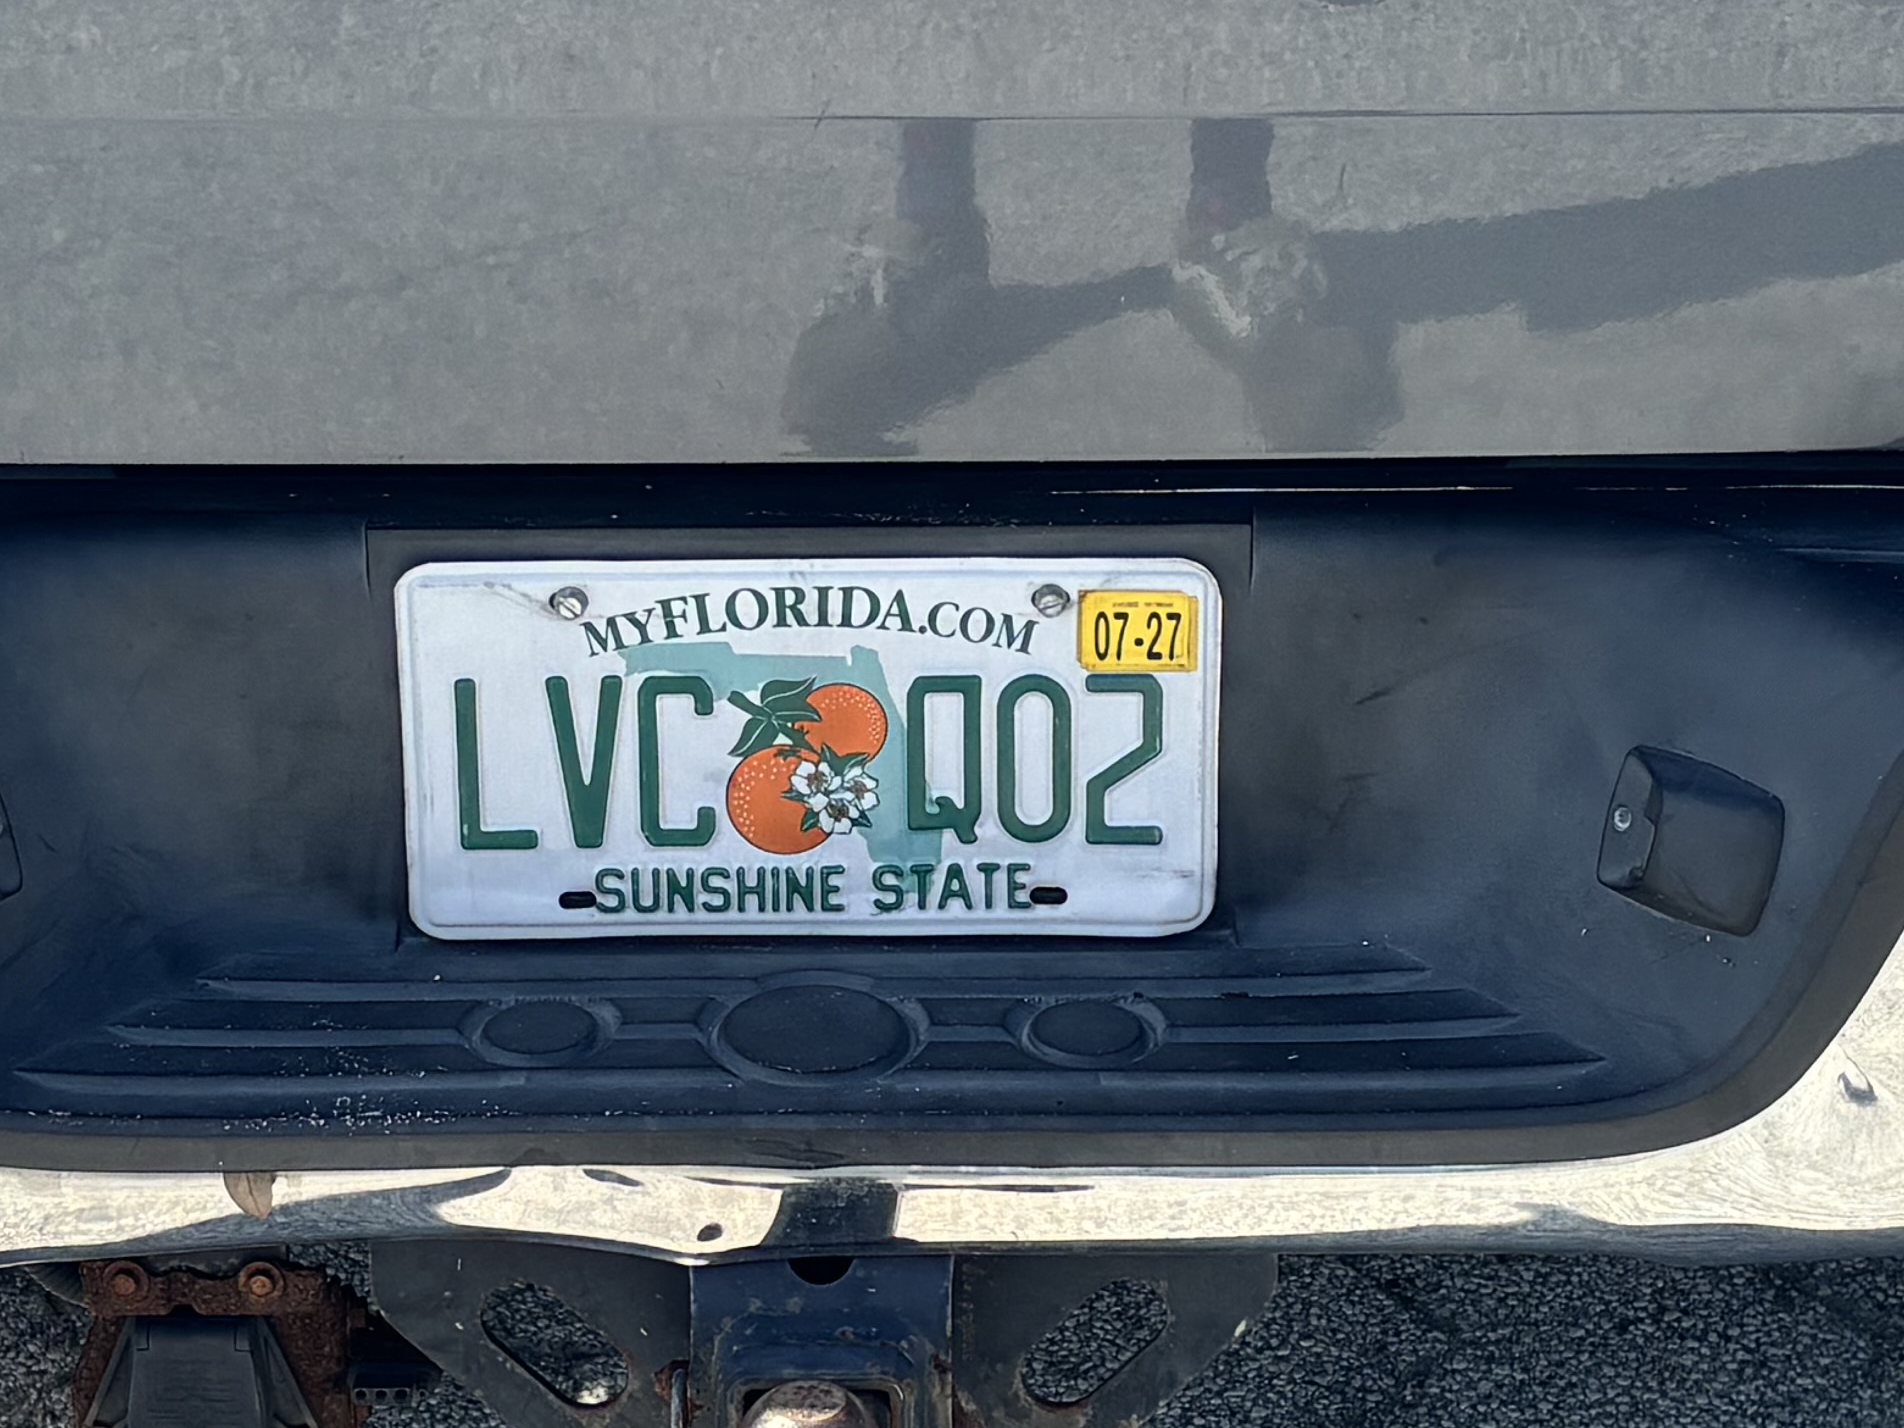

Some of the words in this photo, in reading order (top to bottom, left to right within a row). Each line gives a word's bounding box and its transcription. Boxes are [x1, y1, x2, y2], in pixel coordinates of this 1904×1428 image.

[454, 673, 716, 850] LVC
[594, 864, 844, 914] SUNSHINE
[872, 862, 1034, 914] STATE
